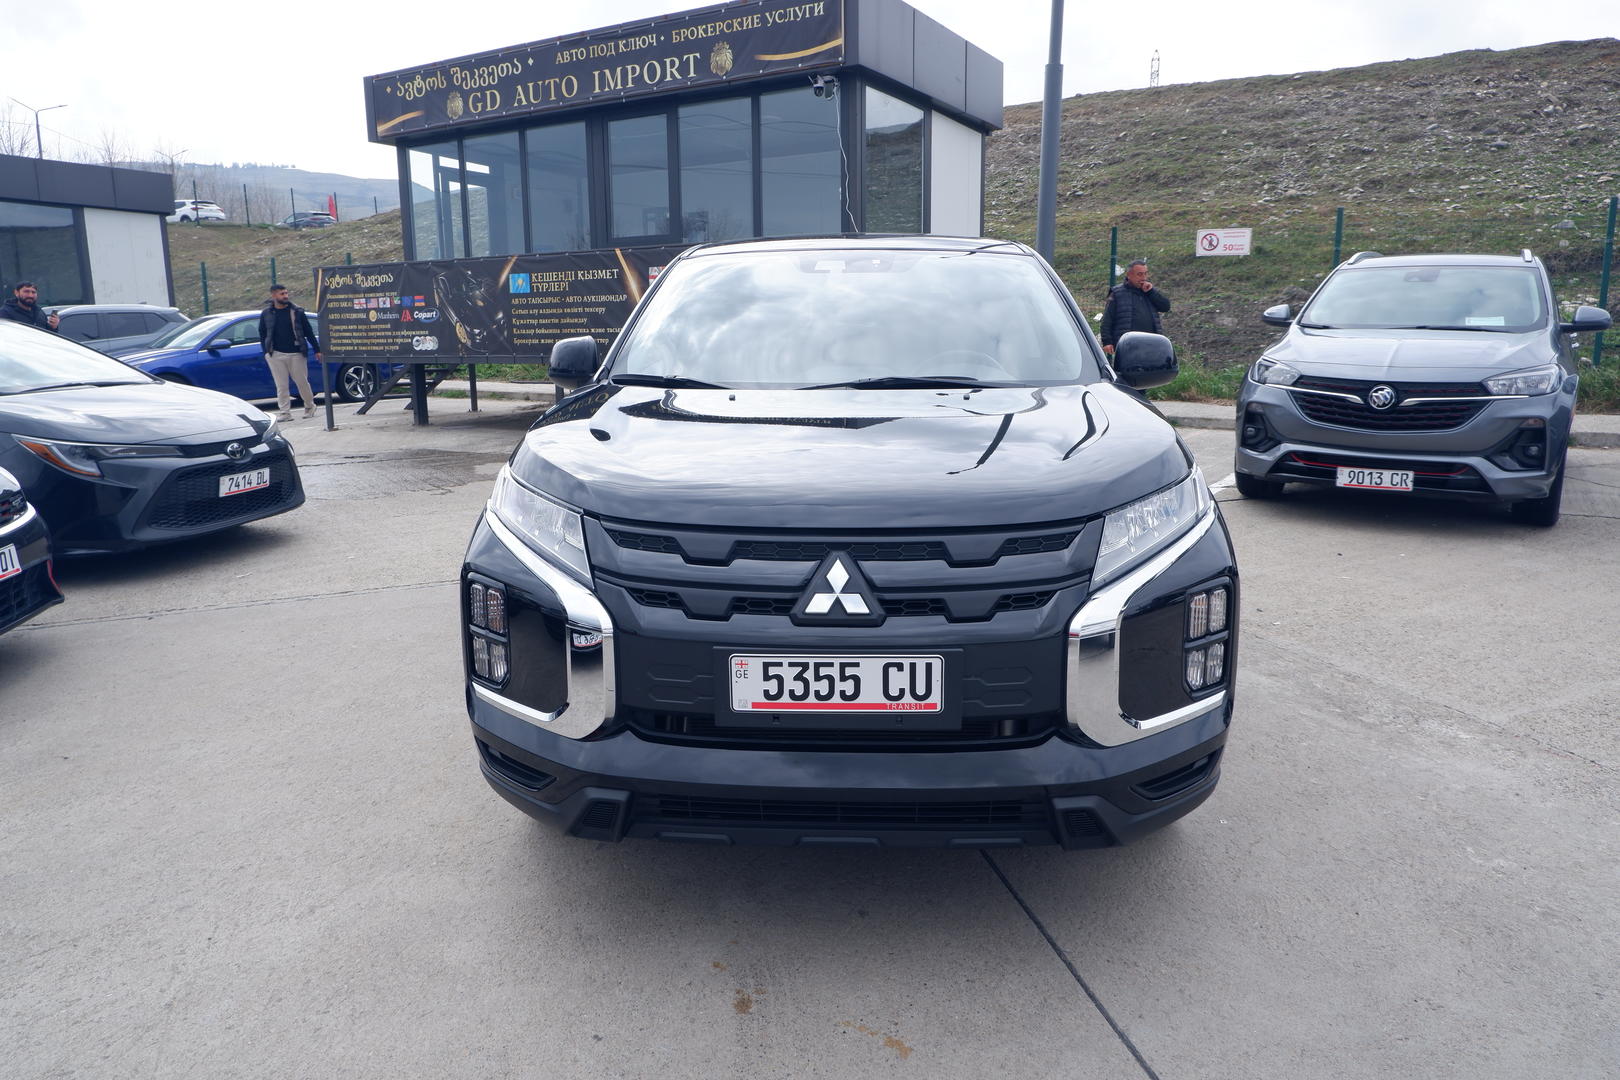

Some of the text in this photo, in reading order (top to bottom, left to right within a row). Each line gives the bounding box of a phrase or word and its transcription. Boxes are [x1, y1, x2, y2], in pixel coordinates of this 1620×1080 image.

[671, 1, 825, 43] БРОКЕРСКИЕ УСЛУГИ
[555, 33, 657, 64] АВТО ПОД КЛЮЧ
[396, 58, 522, 100] ავტოს შეკვეთა
[468, 52, 701, 114] GD AUTO IMPORT
[565, 295, 582, 303] АВТО
[413, 311, 437, 320] Copart
[228, 471, 268, 491] 7414 DL
[1348, 470, 1409, 487] 9013 CR
[735, 669, 749, 679] GE
[762, 661, 933, 702] 5355 CU
